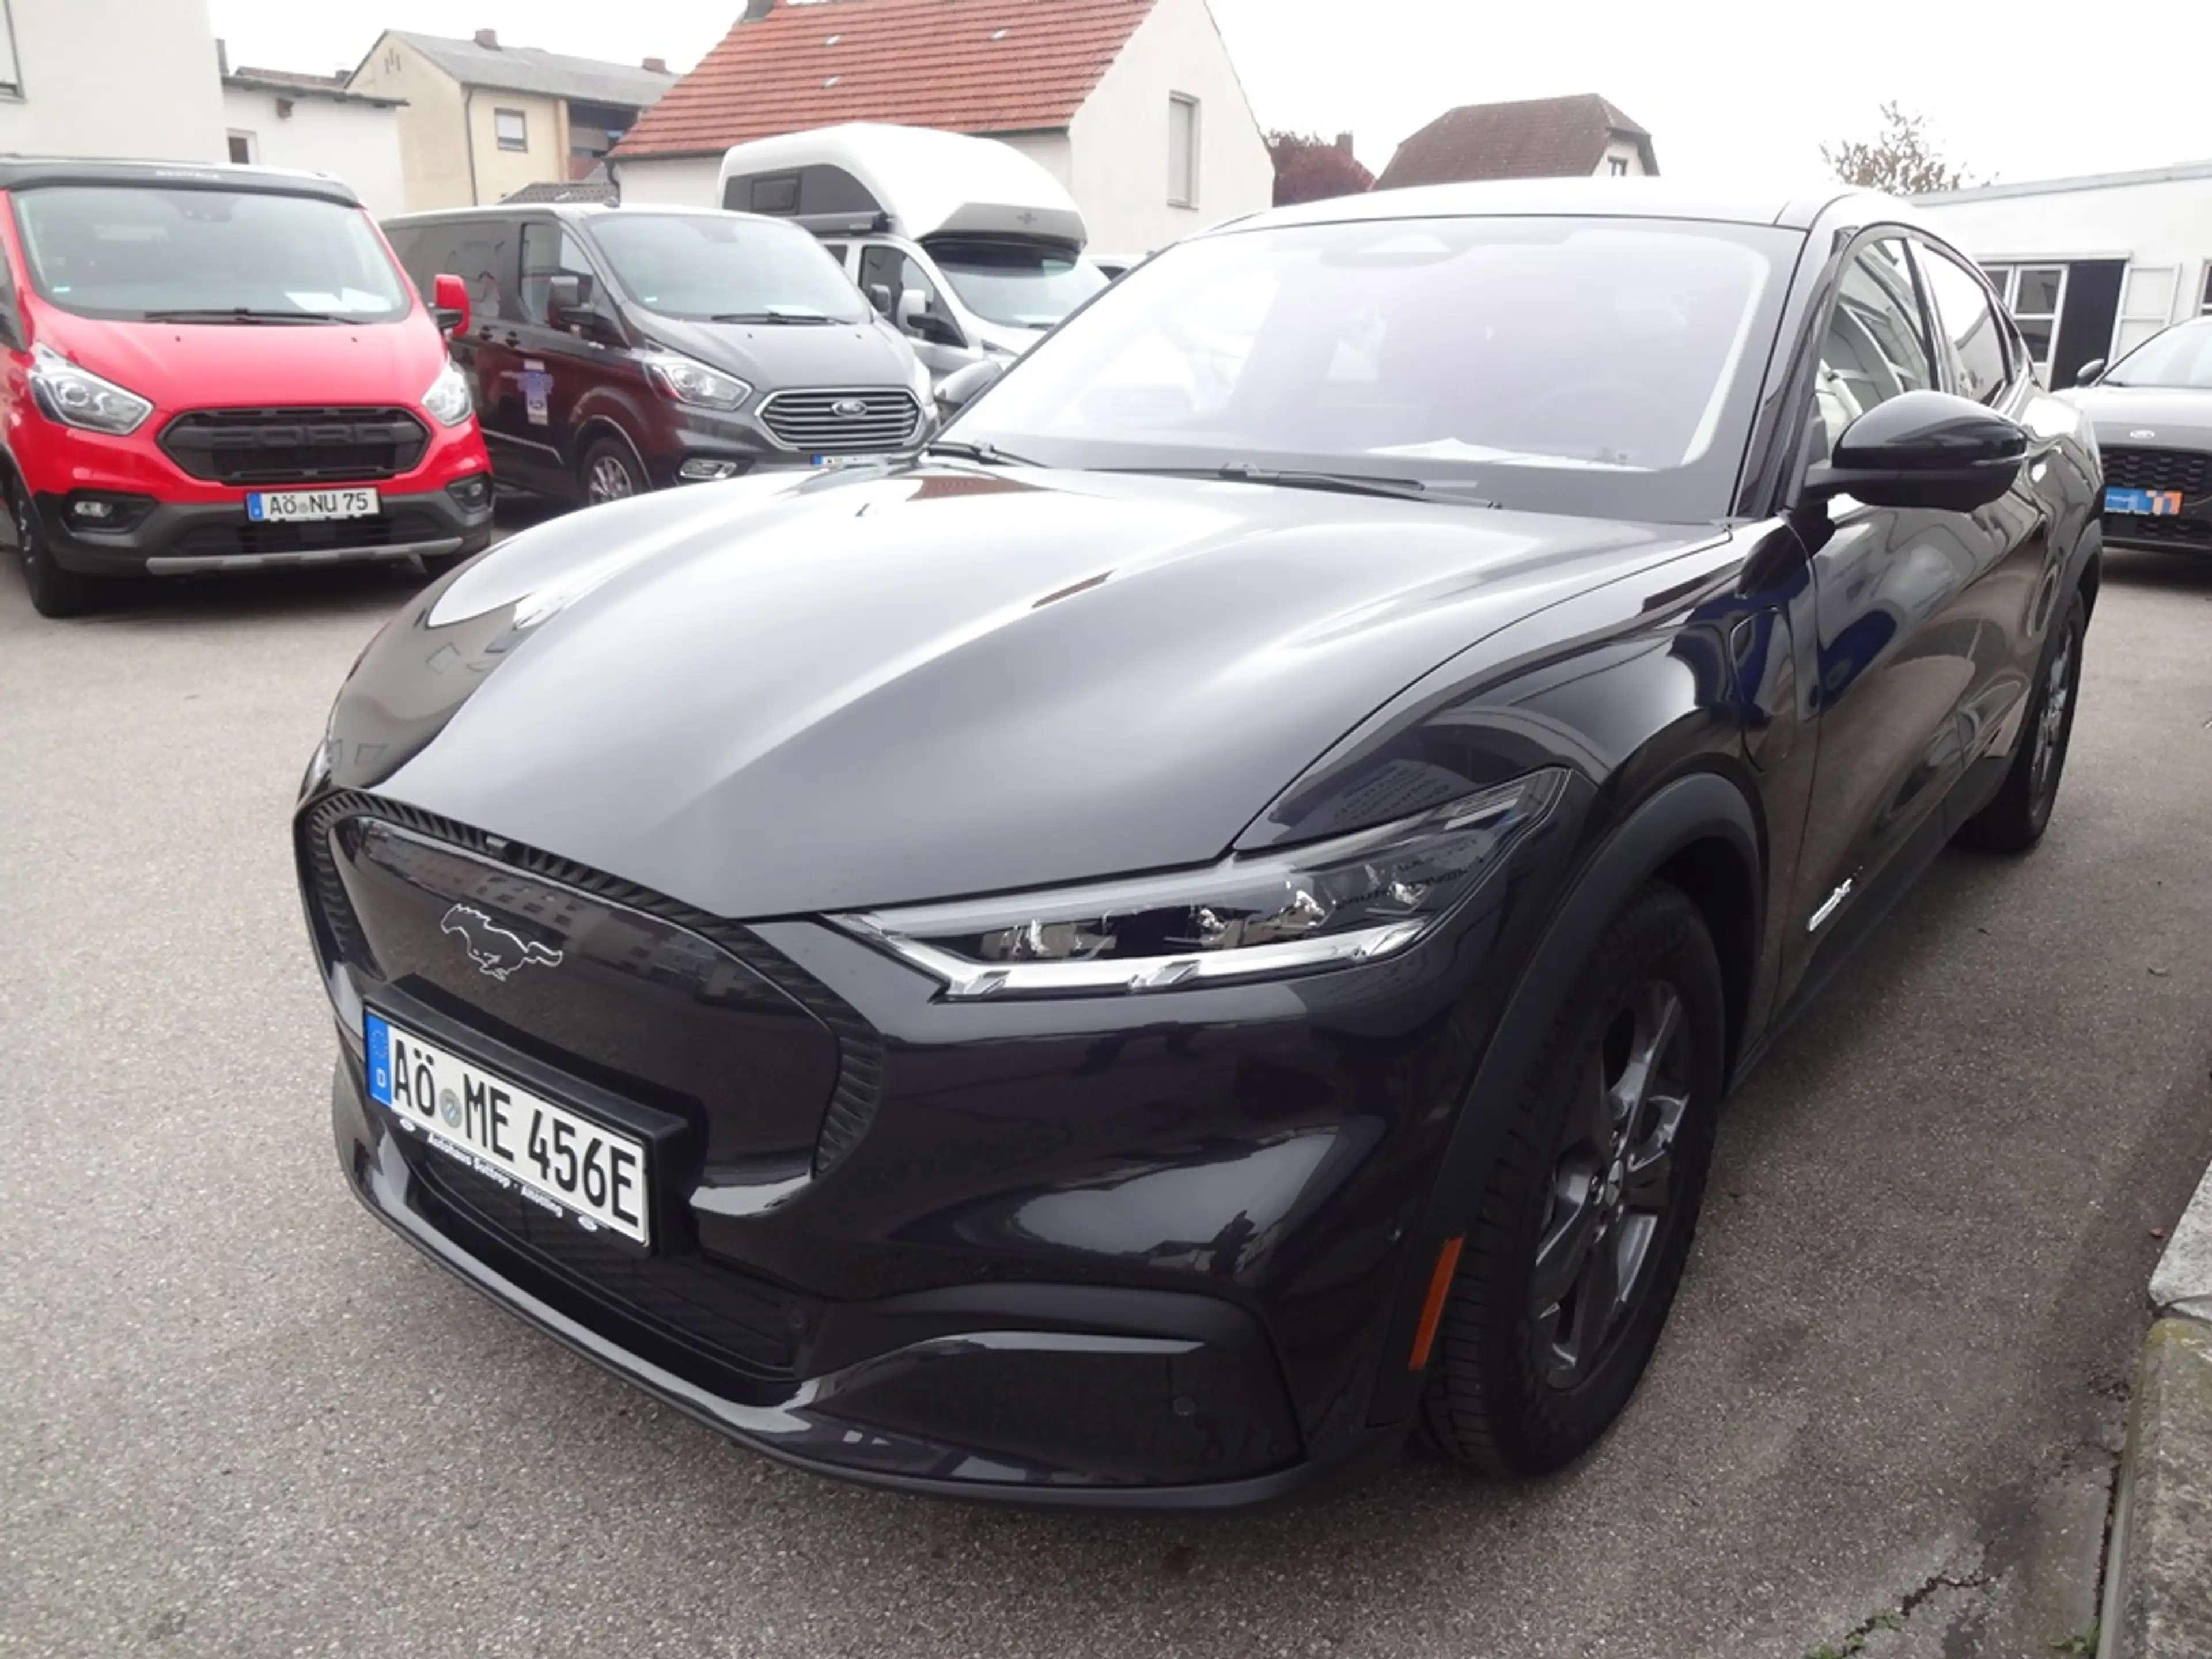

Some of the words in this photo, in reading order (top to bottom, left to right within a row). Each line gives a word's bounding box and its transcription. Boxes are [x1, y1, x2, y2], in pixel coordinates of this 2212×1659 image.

[270, 495, 297, 515] AÖ
[309, 494, 338, 513] NU
[343, 492, 368, 512] 75
[376, 1067, 387, 1088] D
[395, 1039, 435, 1118] AÖ
[463, 1073, 514, 1163] ME
[528, 1108, 639, 1228] 456E
